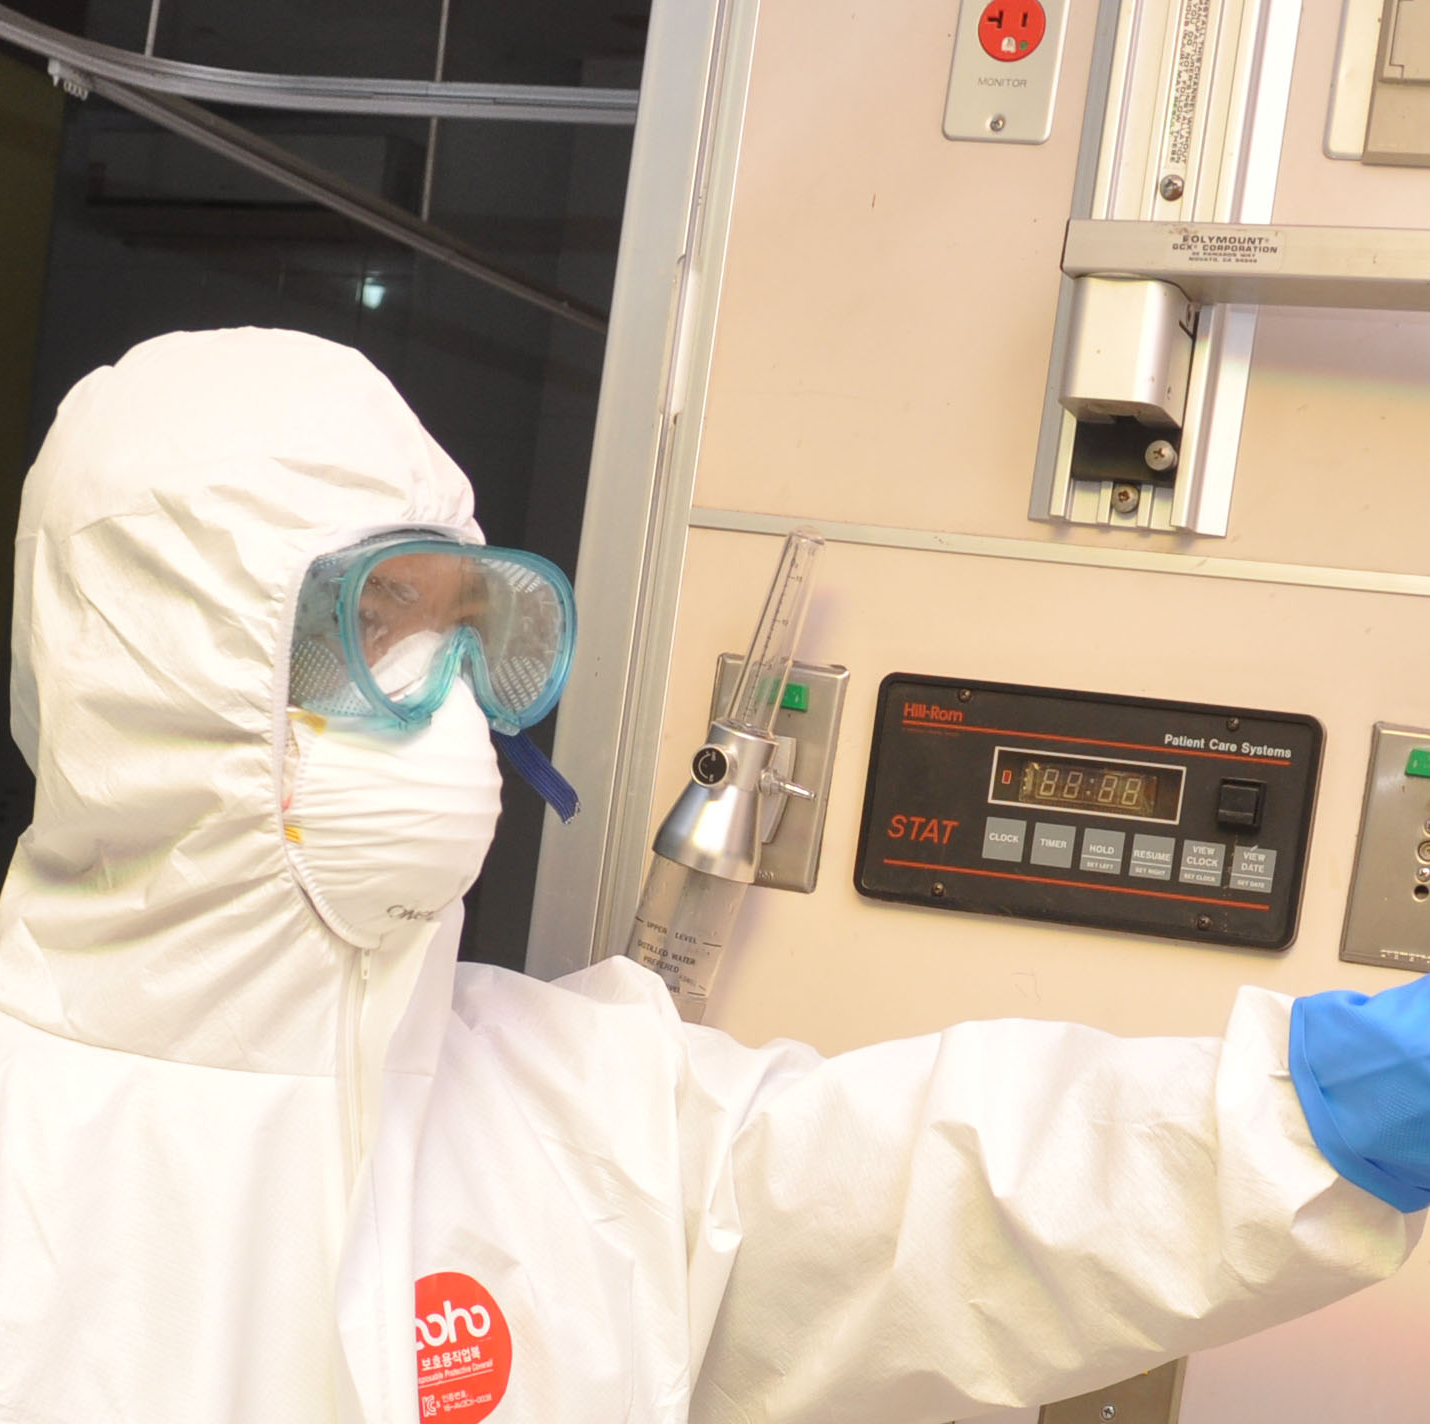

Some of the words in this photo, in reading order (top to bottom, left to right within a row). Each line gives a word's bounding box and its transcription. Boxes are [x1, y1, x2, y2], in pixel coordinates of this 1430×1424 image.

[978, 77, 1027, 88] MONITOR
[1203, 244, 1278, 254] CORPORATION
[903, 703, 964, 722] Hill-Rom
[1163, 733, 1205, 750] Patient
[1208, 738, 1237, 753] Care
[1240, 741, 1292, 760] Systems
[887, 814, 960, 847] STAT
[988, 832, 1019, 844] CLOCK
[1039, 838, 1067, 849] TIMER
[1089, 843, 1115, 855] HOLD
[1192, 845, 1216, 856] VIEW
[1133, 850, 1171, 862] RESUME
[1186, 855, 1219, 868] CLOCK
[1243, 850, 1267, 862] VIEW
[1241, 862, 1265, 874] DATE
[646, 921, 668, 935] UPPER
[674, 932, 698, 945] LEVEL
[671, 953, 696, 965] WATER
